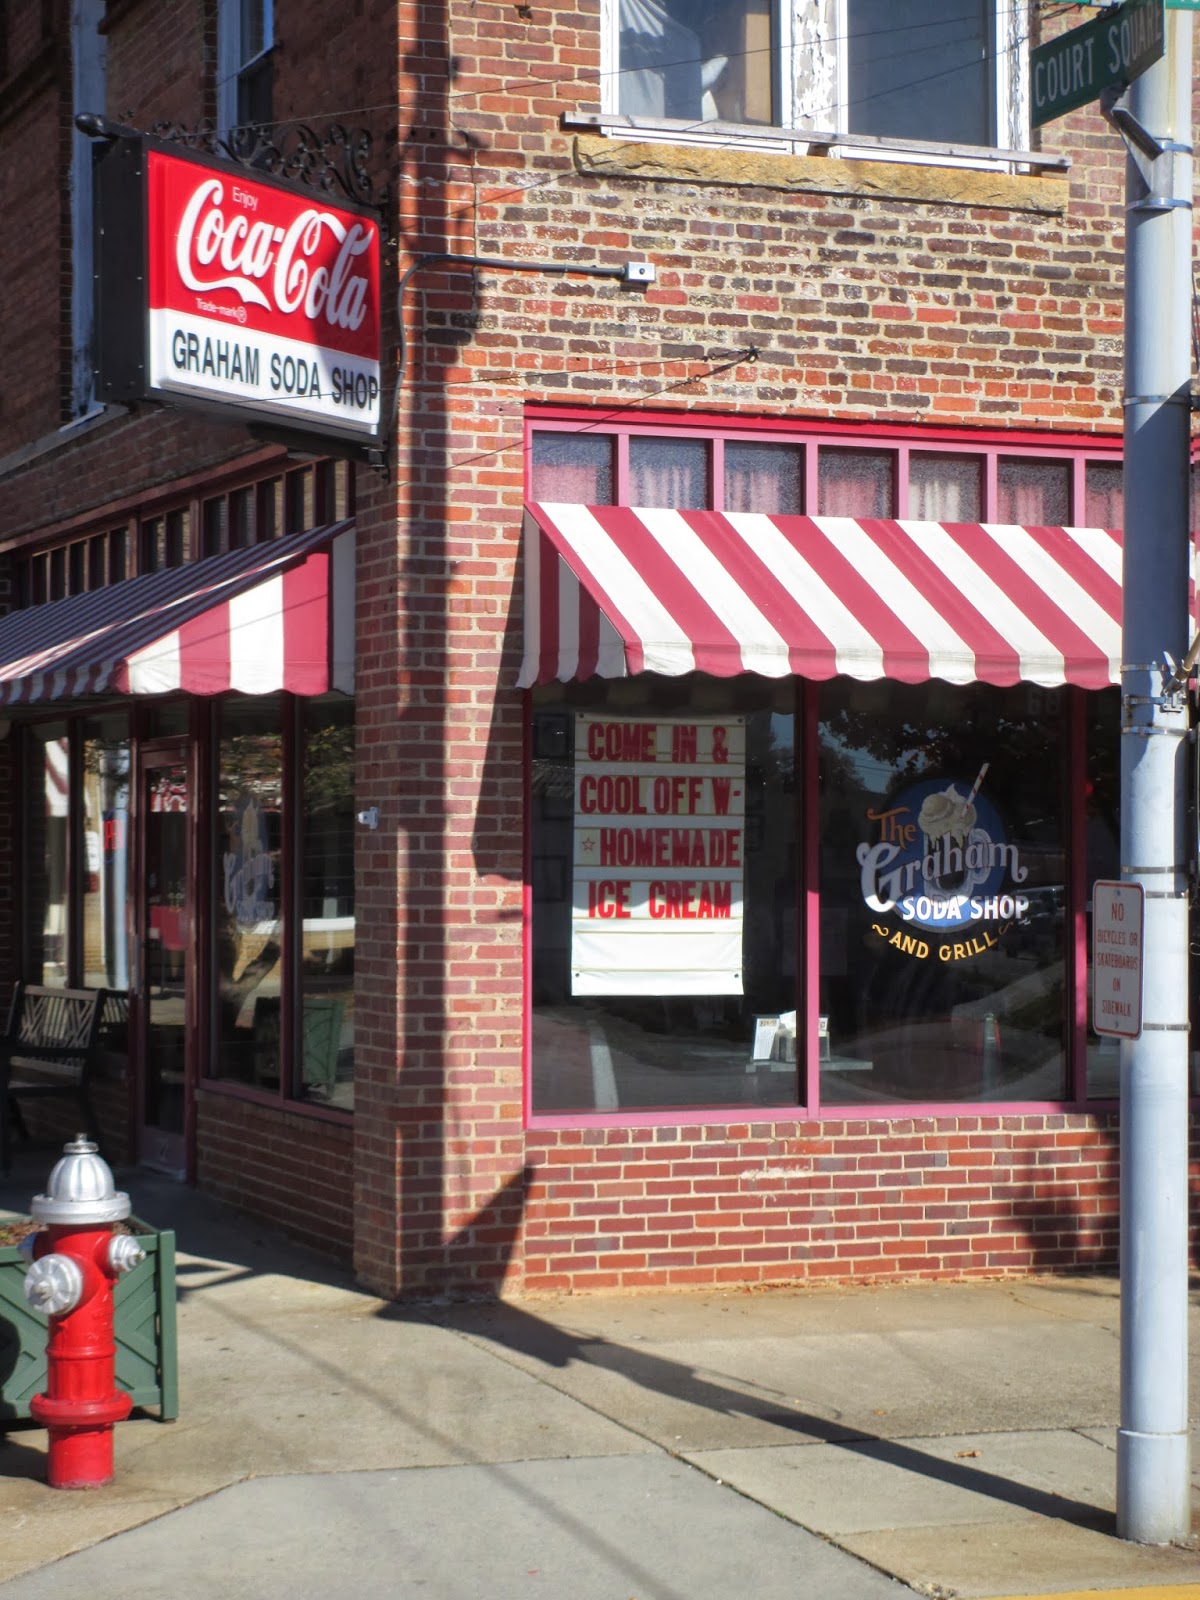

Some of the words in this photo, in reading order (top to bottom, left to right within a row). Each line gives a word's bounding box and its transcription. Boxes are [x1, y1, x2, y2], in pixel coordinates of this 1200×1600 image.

[1034, 37, 1095, 108] COURT
[1108, 1, 1162, 74] SQUARE
[232, 186, 258, 211] Enjoy
[176, 179, 374, 331] Coca-Cola
[172, 328, 260, 387] GRAHAM
[270, 352, 321, 400] SODA
[331, 366, 379, 411] SHOP
[588, 722, 657, 762] COME
[671, 725, 697, 764] IN
[712, 726, 729, 764] &
[579, 775, 647, 815] COOL
[654, 776, 703, 815] OFF
[867, 806, 917, 849] The
[600, 828, 741, 867] HOMEMADE
[856, 832, 1029, 913] Graham
[588, 880, 631, 918] ICE
[649, 880, 731, 919] CREAM
[902, 895, 962, 921] SODA
[970, 895, 1030, 920] SHOP
[1111, 903, 1125, 922] NO
[889, 931, 930, 960] AND
[938, 931, 998, 962] GRILL
[1097, 929, 1126, 947] BICYCLES
[1129, 932, 1138, 947] OR
[1096, 952, 1138, 971] SKATEBOARDS
[1112, 977, 1121, 992] ON
[1101, 999, 1132, 1018] SIDEWALK
